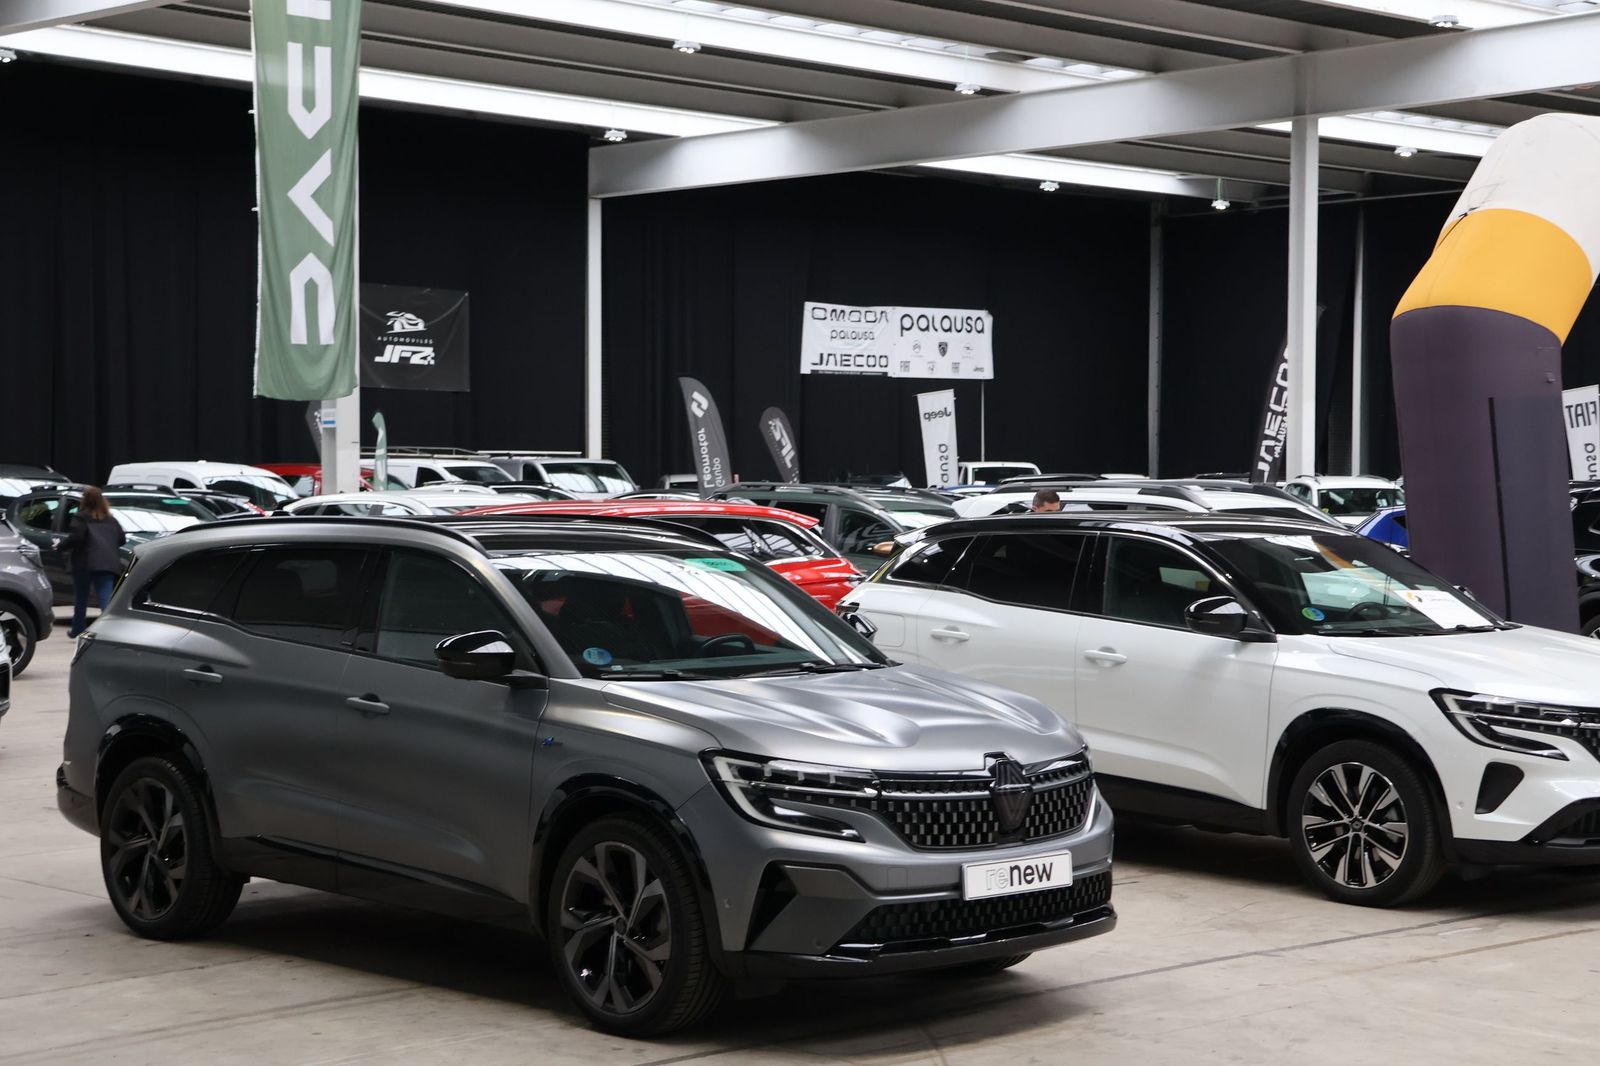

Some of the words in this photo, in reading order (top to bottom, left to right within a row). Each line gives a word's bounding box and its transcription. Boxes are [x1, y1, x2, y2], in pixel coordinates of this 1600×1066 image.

[287, 0, 335, 345] DACI
[812, 307, 889, 323] OMODA
[901, 314, 985, 337] palausa
[830, 330, 875, 341] palausa
[374, 344, 435, 365] JFZ
[811, 353, 888, 368] JAECOO
[986, 862, 1053, 891] renew
